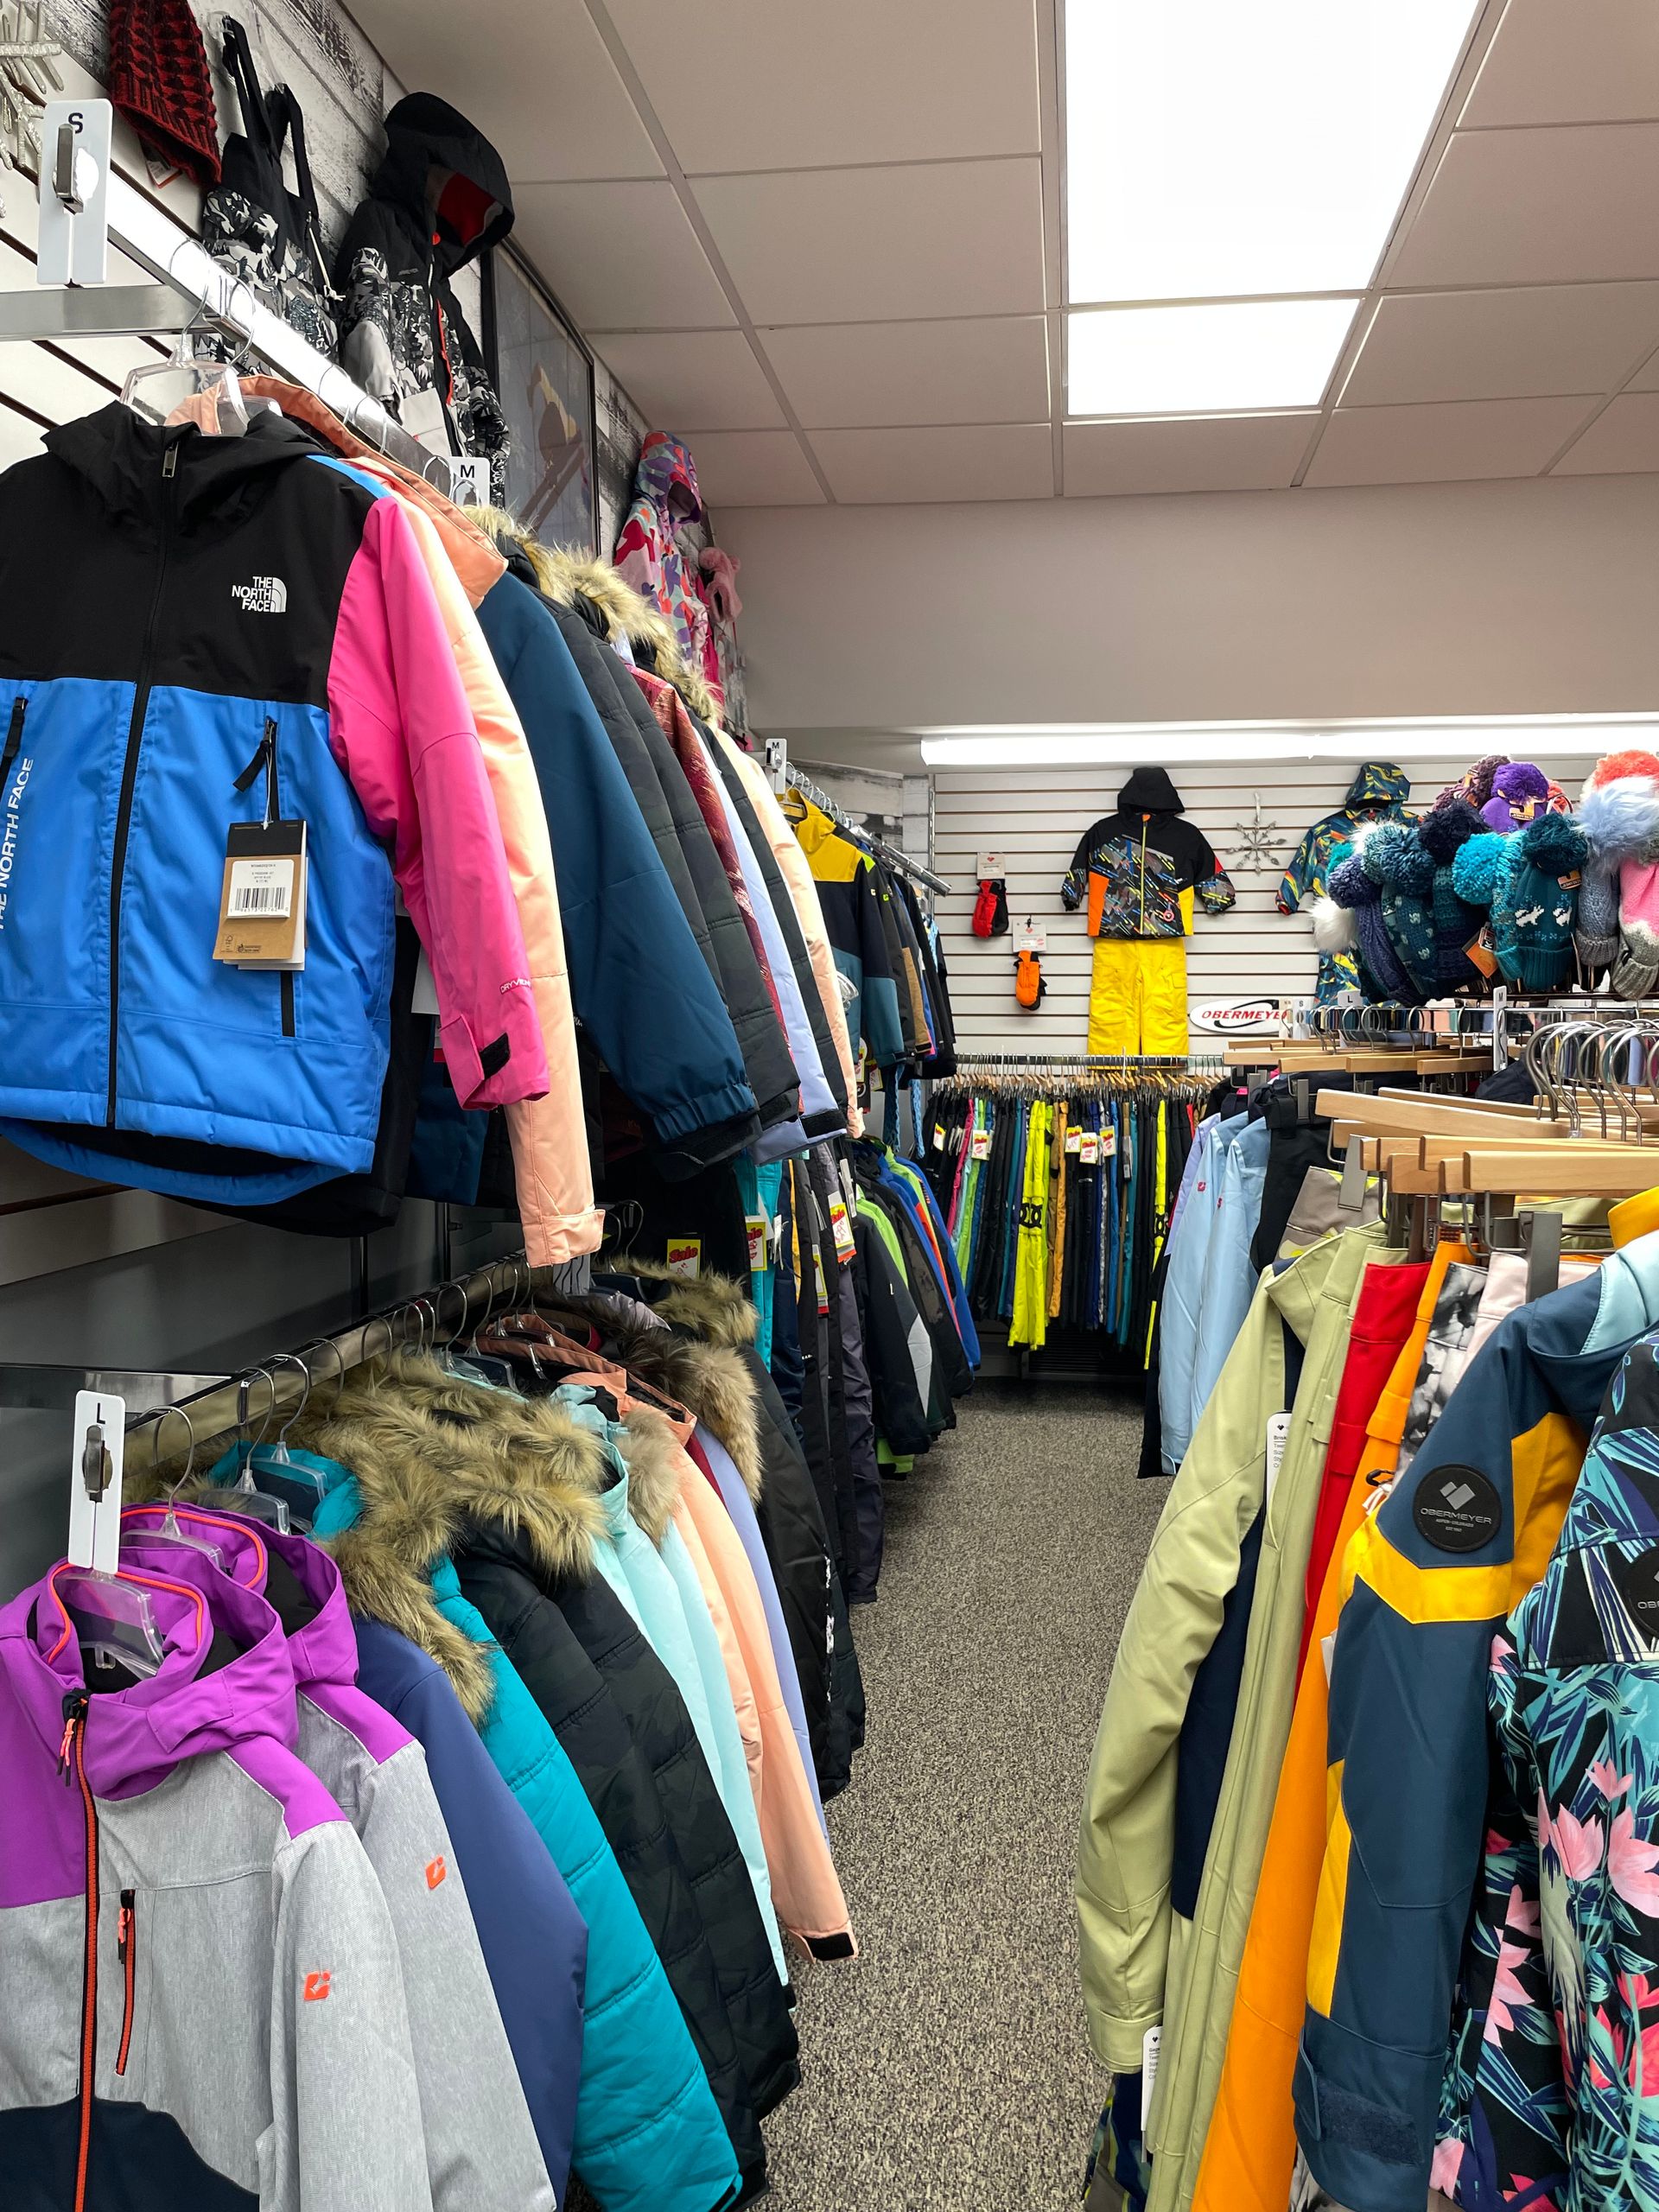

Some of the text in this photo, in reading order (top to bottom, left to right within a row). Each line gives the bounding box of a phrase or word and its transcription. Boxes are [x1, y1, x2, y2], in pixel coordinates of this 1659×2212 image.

[68, 112, 83, 134] S
[461, 464, 475, 478] M
[252, 576, 272, 588] THE
[232, 585, 271, 600] NORTH
[242, 598, 270, 612] FACE
[8, 758, 34, 810] FACE
[0, 813, 19, 888] NORTH
[669, 1245, 698, 1263] Sale
[97, 1402, 105, 1424] L
[1421, 1508, 1491, 1524] OBERMEYER
